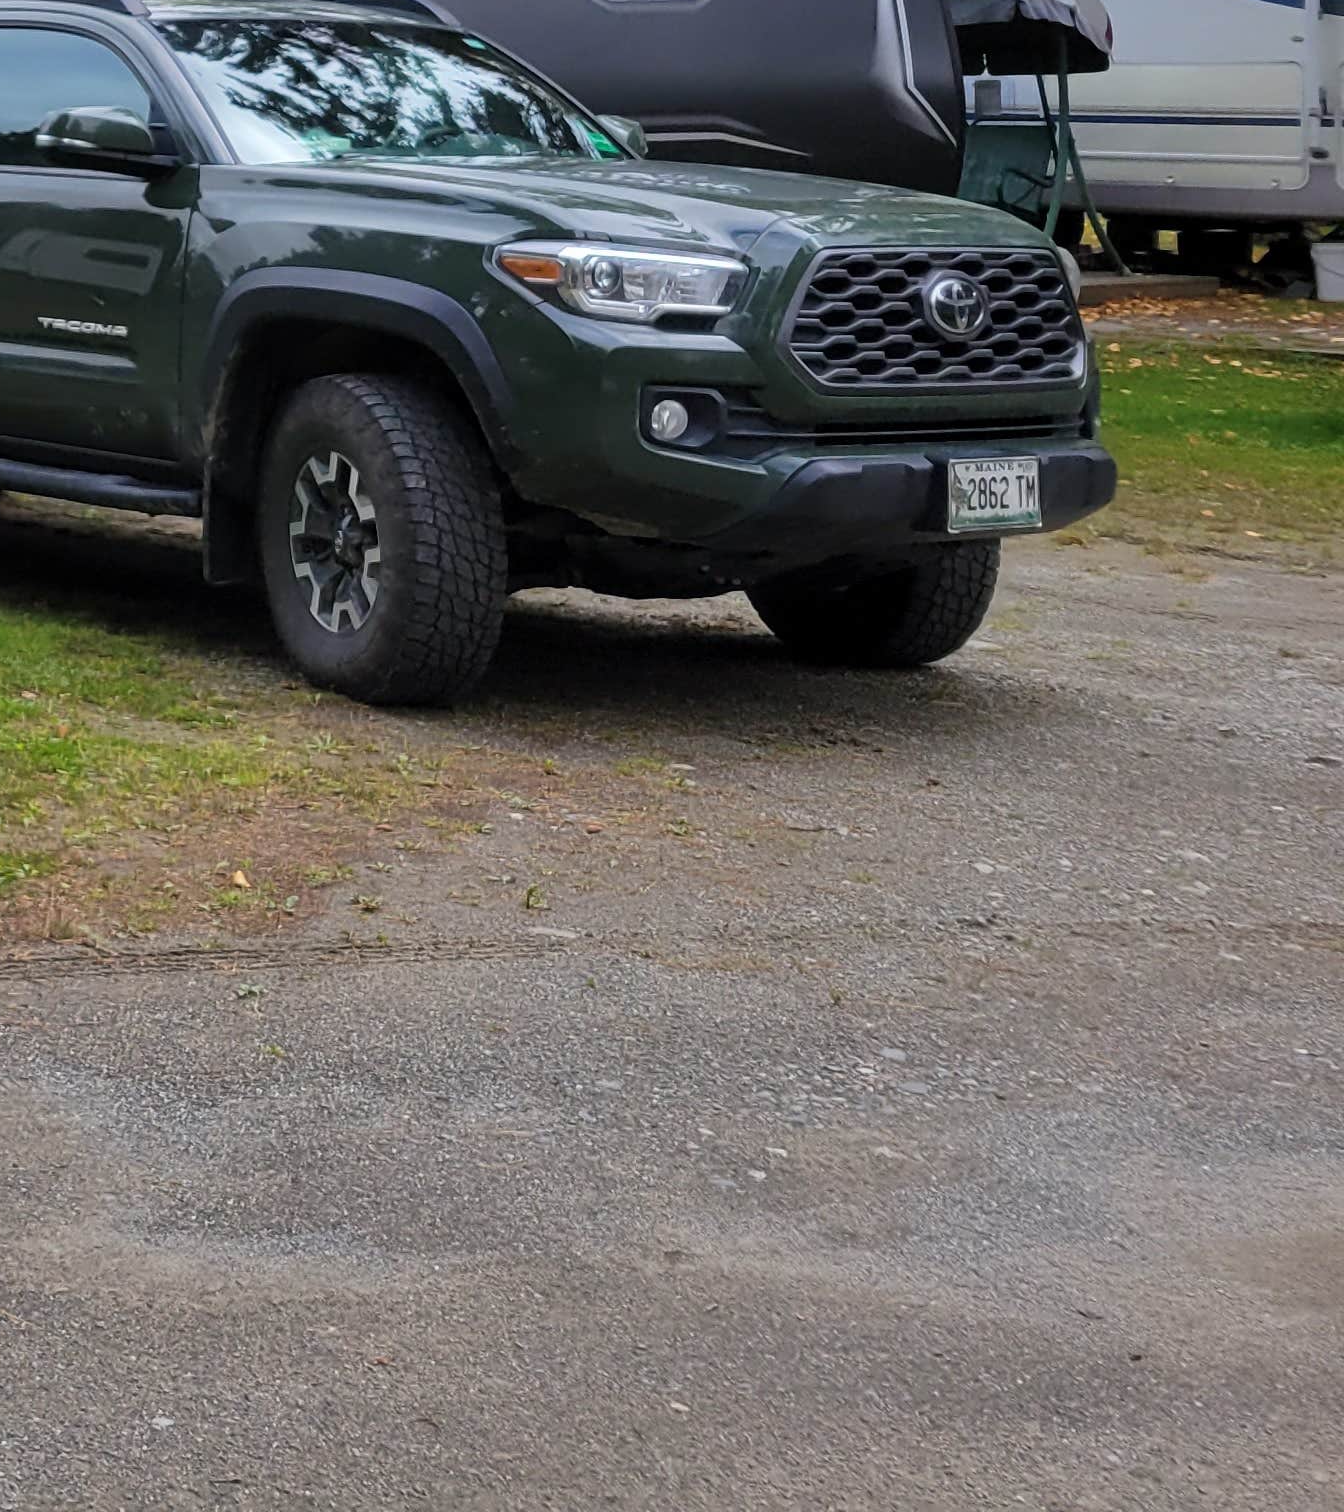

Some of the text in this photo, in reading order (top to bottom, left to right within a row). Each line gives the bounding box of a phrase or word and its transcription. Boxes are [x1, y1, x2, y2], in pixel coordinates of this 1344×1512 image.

[37, 316, 128, 337] TACOMA
[975, 462, 1014, 473] MAINE
[967, 474, 1036, 511] 2862 TM
